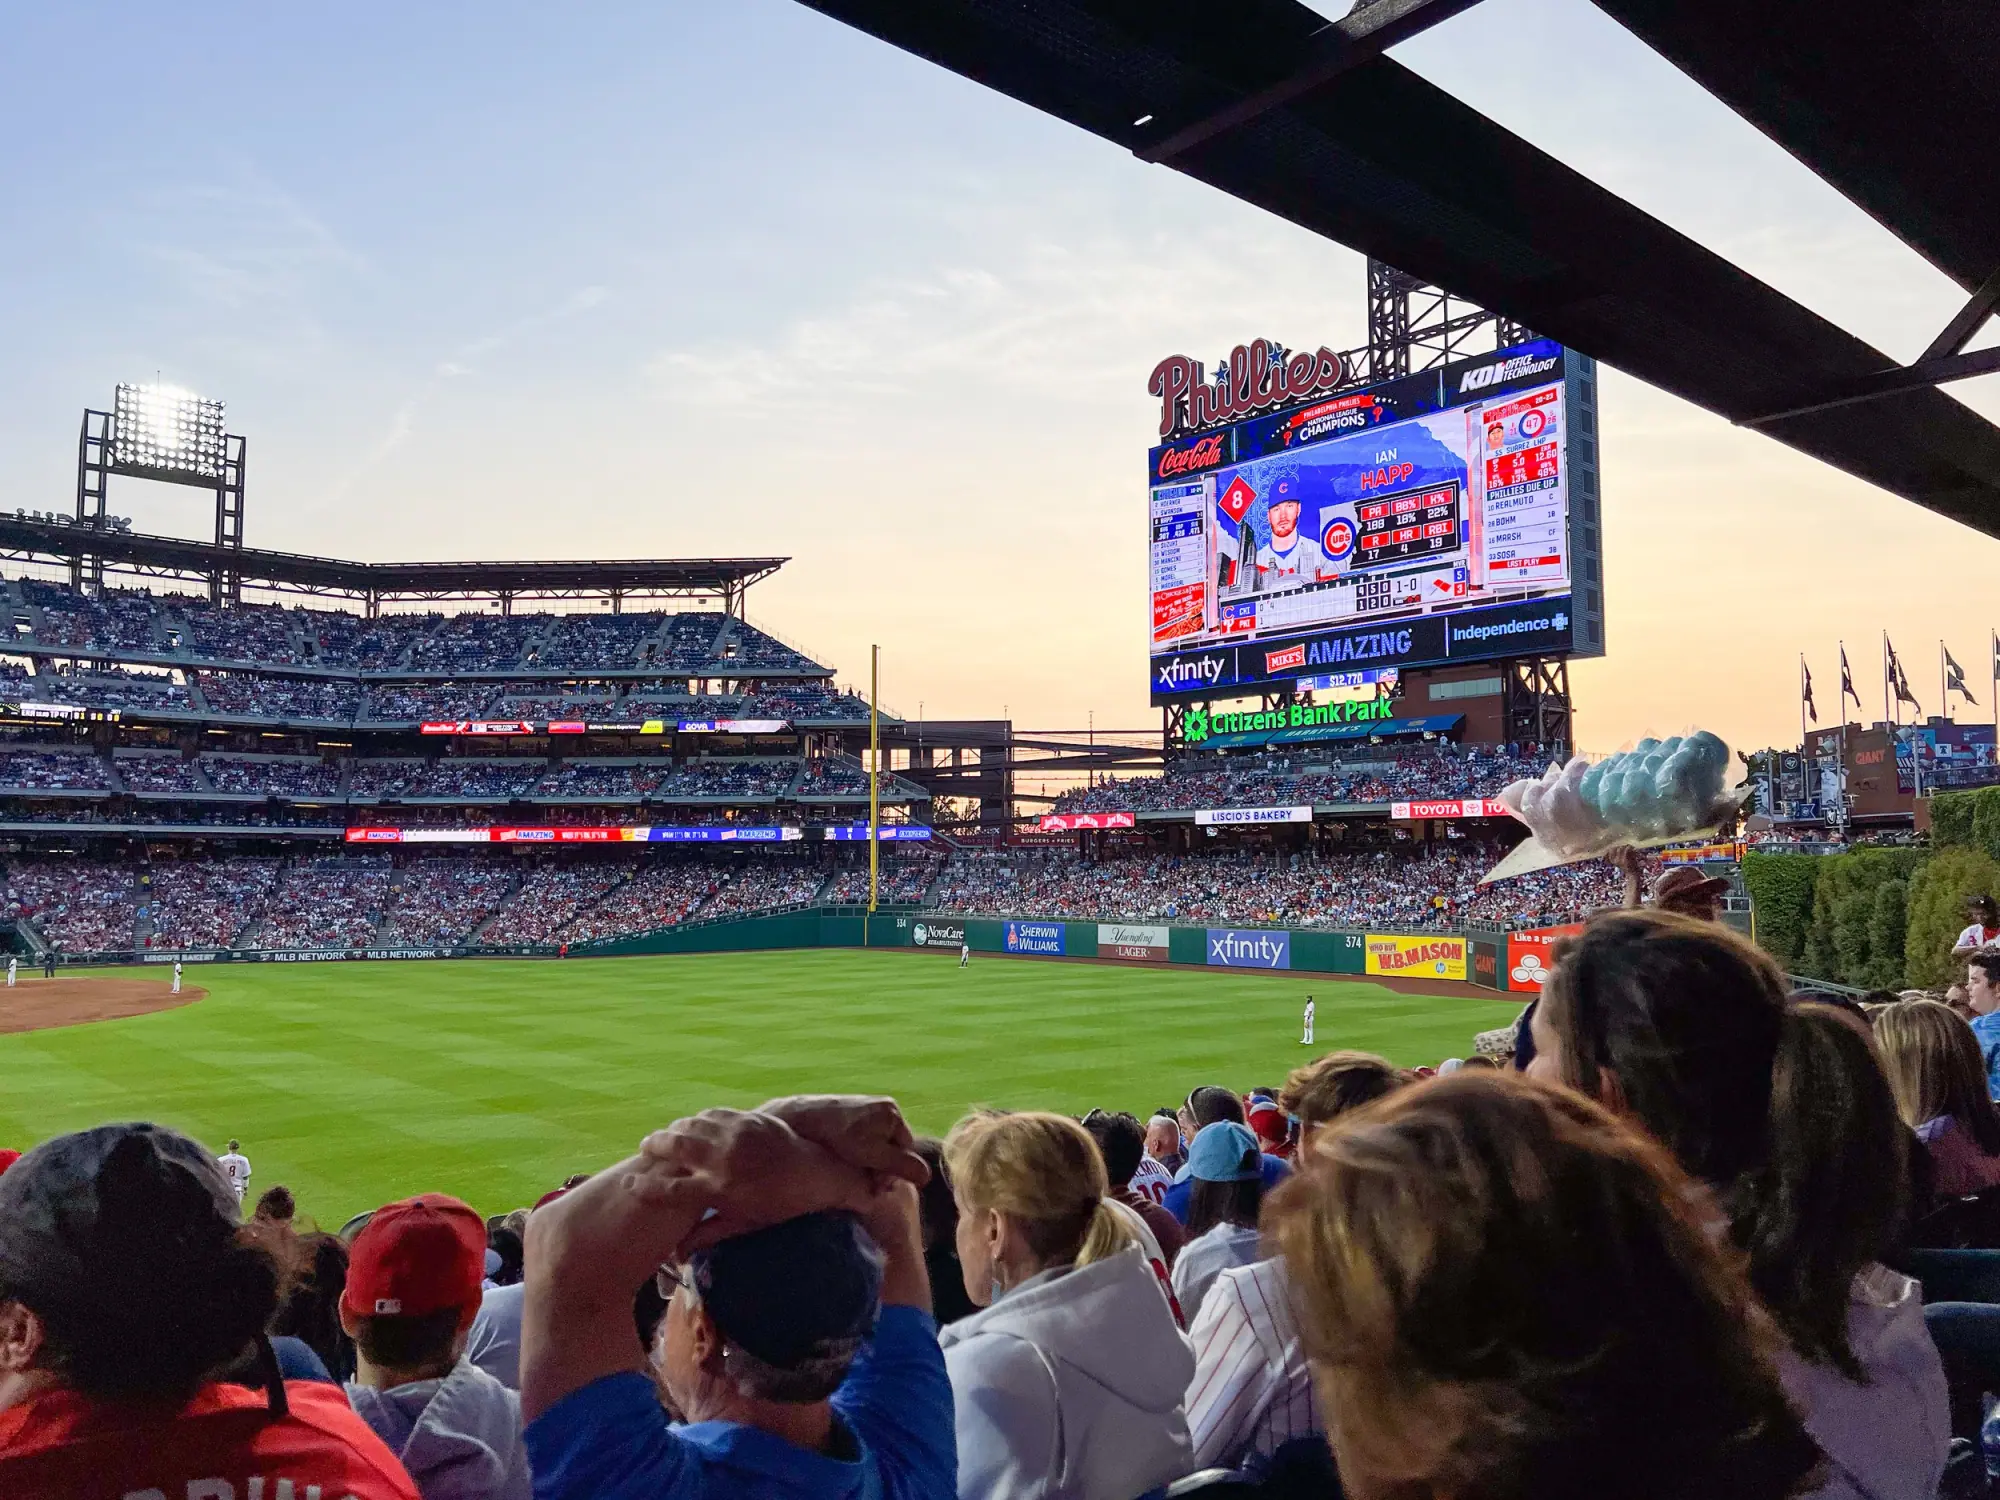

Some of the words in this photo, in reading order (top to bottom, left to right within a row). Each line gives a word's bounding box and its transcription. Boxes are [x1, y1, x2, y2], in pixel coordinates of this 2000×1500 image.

[1503, 357, 1557, 382] TECHNOLOGY
[1505, 354, 1534, 370] OFFICE
[1148, 337, 1343, 437] Phillies
[1303, 401, 1338, 420] PHILADELPHIA
[1338, 396, 1361, 409] PHILLIES
[1307, 413, 1336, 427] NATIONAL
[1336, 407, 1358, 420] LEAGUE
[1526, 417, 1539, 429] 47
[1300, 413, 1365, 441] CHAMPIONS
[1375, 448, 1397, 464] IAN
[1512, 456, 1525, 467] 5.0
[1535, 449, 1557, 462] 12.60
[1361, 462, 1413, 490] HAPP
[1488, 479, 1504, 489] 16%
[1511, 474, 1527, 484] 13%
[1537, 468, 1556, 478] 48%
[1490, 483, 1524, 500] PHILLIES
[1526, 481, 1541, 491] DUE
[1543, 479, 1555, 488] UP
[1232, 490, 1243, 509] 8
[1369, 506, 1382, 517] PA
[1395, 500, 1416, 511] BB%
[1430, 493, 1445, 504] K%
[1495, 495, 1534, 510] REALMUTO
[1367, 519, 1385, 531] 188
[1396, 513, 1417, 525] 18%
[1427, 506, 1449, 519] 22%
[1496, 515, 1516, 527] BOHM
[1372, 536, 1379, 546] R
[1400, 530, 1413, 540] HR
[1428, 523, 1448, 535] RBI
[1496, 532, 1522, 543] MARSH
[1368, 549, 1380, 560] 17
[1400, 544, 1408, 554] 4
[1429, 537, 1443, 548] 19
[1496, 550, 1516, 560] SOSA
[1506, 560, 1522, 568] LAST
[1523, 558, 1540, 566] PLAY
[1358, 584, 1365, 595] 4
[1370, 582, 1376, 593] 5
[1382, 581, 1388, 591] 0
[1397, 578, 1417, 593] 1-0
[1456, 570, 1463, 580] 5
[1359, 599, 1364, 609] 1
[1370, 597, 1377, 607] 2
[1383, 595, 1388, 606] 0
[1456, 584, 1463, 594] 3
[1453, 618, 1549, 641] Independence
[1308, 630, 1412, 665] AMAZING
[1271, 653, 1302, 668] MIKE'S
[1159, 654, 1225, 688] xfinity
[1211, 711, 1287, 734] Citizens
[1290, 699, 1341, 727] Bank
[1345, 695, 1393, 721] Park
[1856, 749, 1885, 765] GIANT
[1211, 811, 1251, 822] LISCIO'S
[1253, 809, 1292, 820] BAKERY
[1413, 803, 1460, 815] TOYOTA
[517, 830, 554, 839] AMAZING
[737, 829, 776, 839] AMAZING
[896, 918, 907, 928] 334
[1019, 924, 1058, 938] SHERWIN
[927, 925, 965, 940] NovaCare
[1514, 933, 1531, 942] Like
[1211, 932, 1285, 967] xfinity
[1345, 936, 1362, 949] 374
[1368, 943, 1381, 952] WHO
[1382, 943, 1397, 952] BUT
[274, 953, 296, 961] MLB
[298, 951, 346, 961] NETWORK
[367, 951, 387, 960] MLB
[389, 950, 436, 959] NETWORK
[1117, 946, 1148, 958] LAGER
[1475, 953, 1496, 974] GIANT
[229, 1166, 236, 1177] 8
